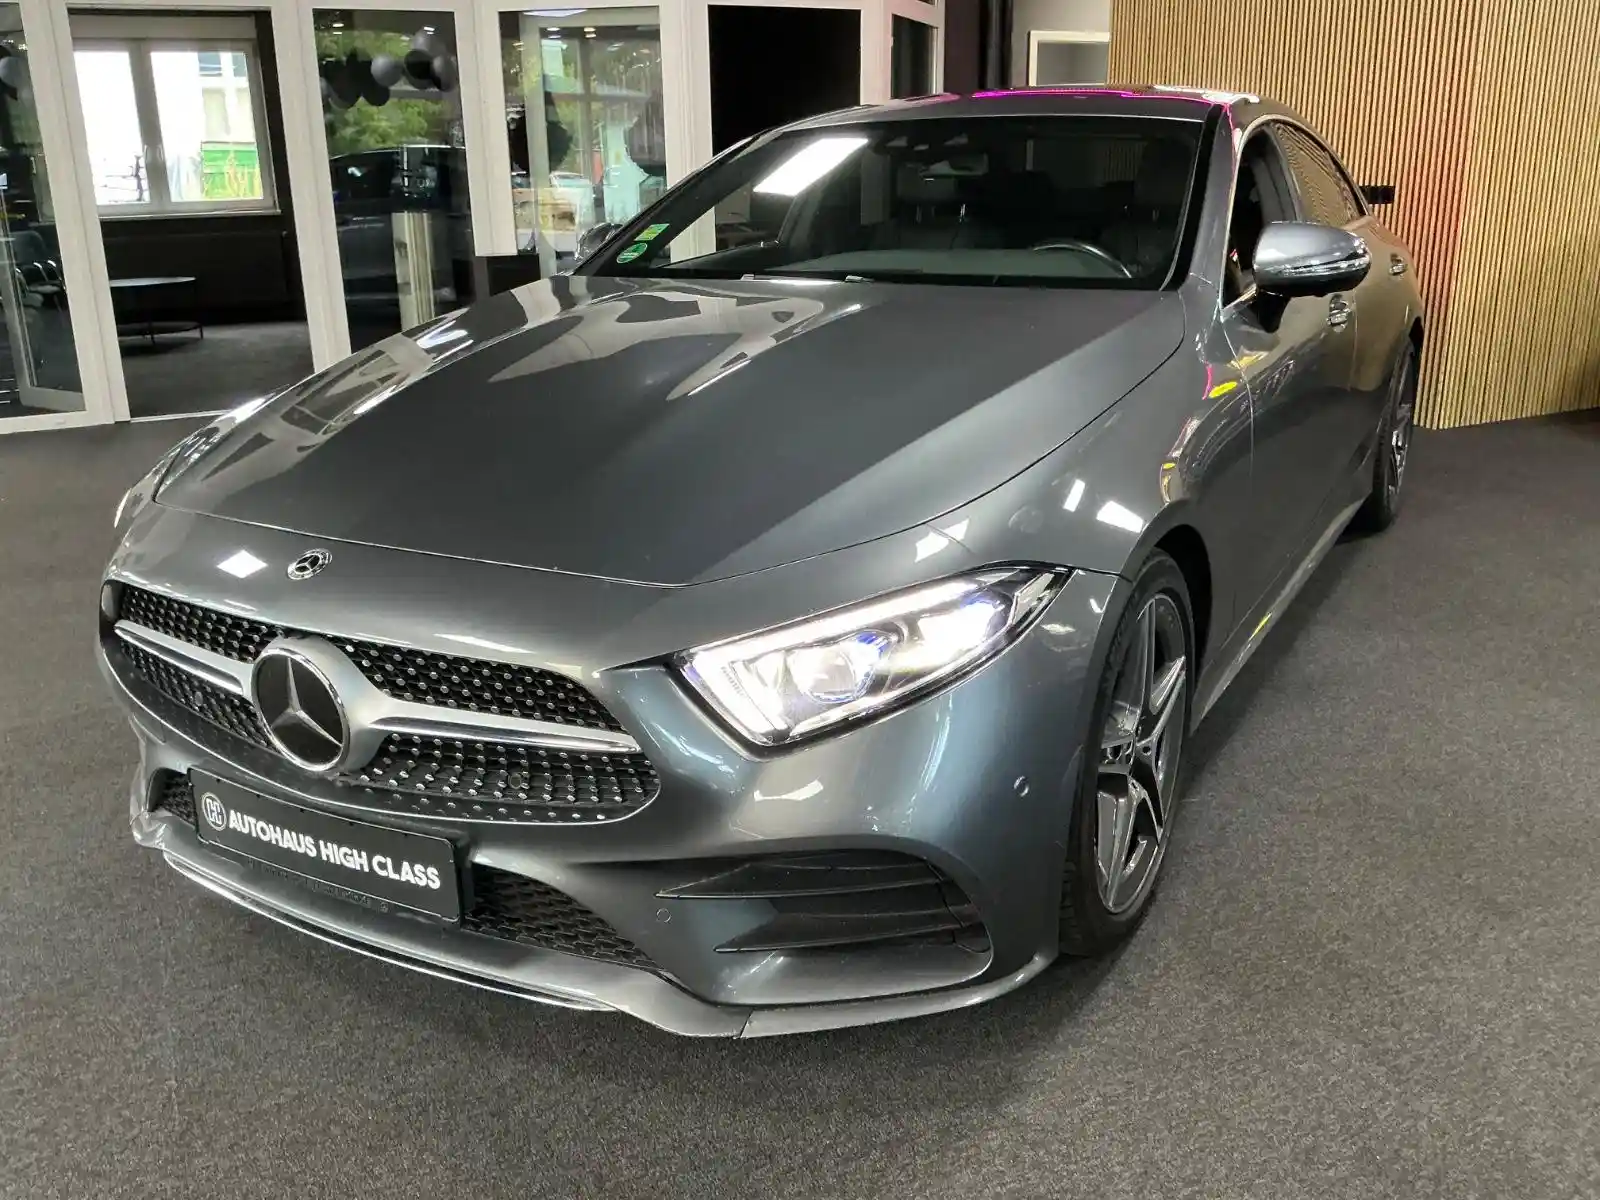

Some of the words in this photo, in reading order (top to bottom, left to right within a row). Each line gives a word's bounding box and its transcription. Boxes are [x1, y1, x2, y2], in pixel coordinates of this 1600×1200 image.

[228, 809, 317, 857] AUTOHAUS
[319, 839, 370, 873] HIGH
[372, 854, 441, 890] CLASS
